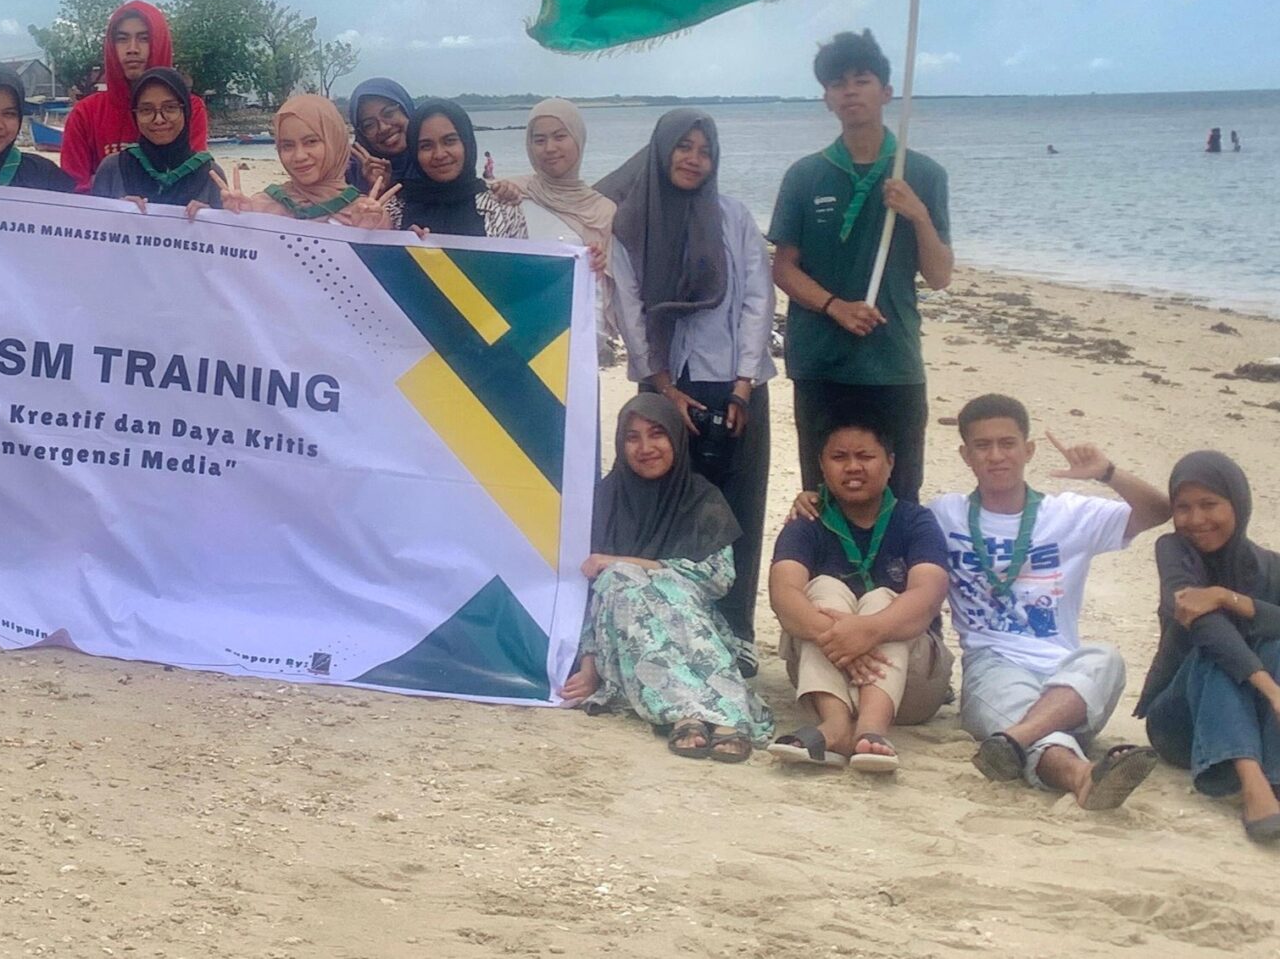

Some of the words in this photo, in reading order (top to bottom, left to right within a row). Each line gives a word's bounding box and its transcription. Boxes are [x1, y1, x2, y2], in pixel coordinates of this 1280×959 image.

[40, 224, 131, 245] MAHASISWA
[135, 235, 215, 254] INDONESIA
[219, 245, 259, 261] NUKU
[93, 345, 341, 413] TRAINING
[10, 404, 106, 430] Kreatif
[114, 414, 161, 436] dan
[172, 418, 235, 445] Daya
[245, 428, 319, 458] Kritis
